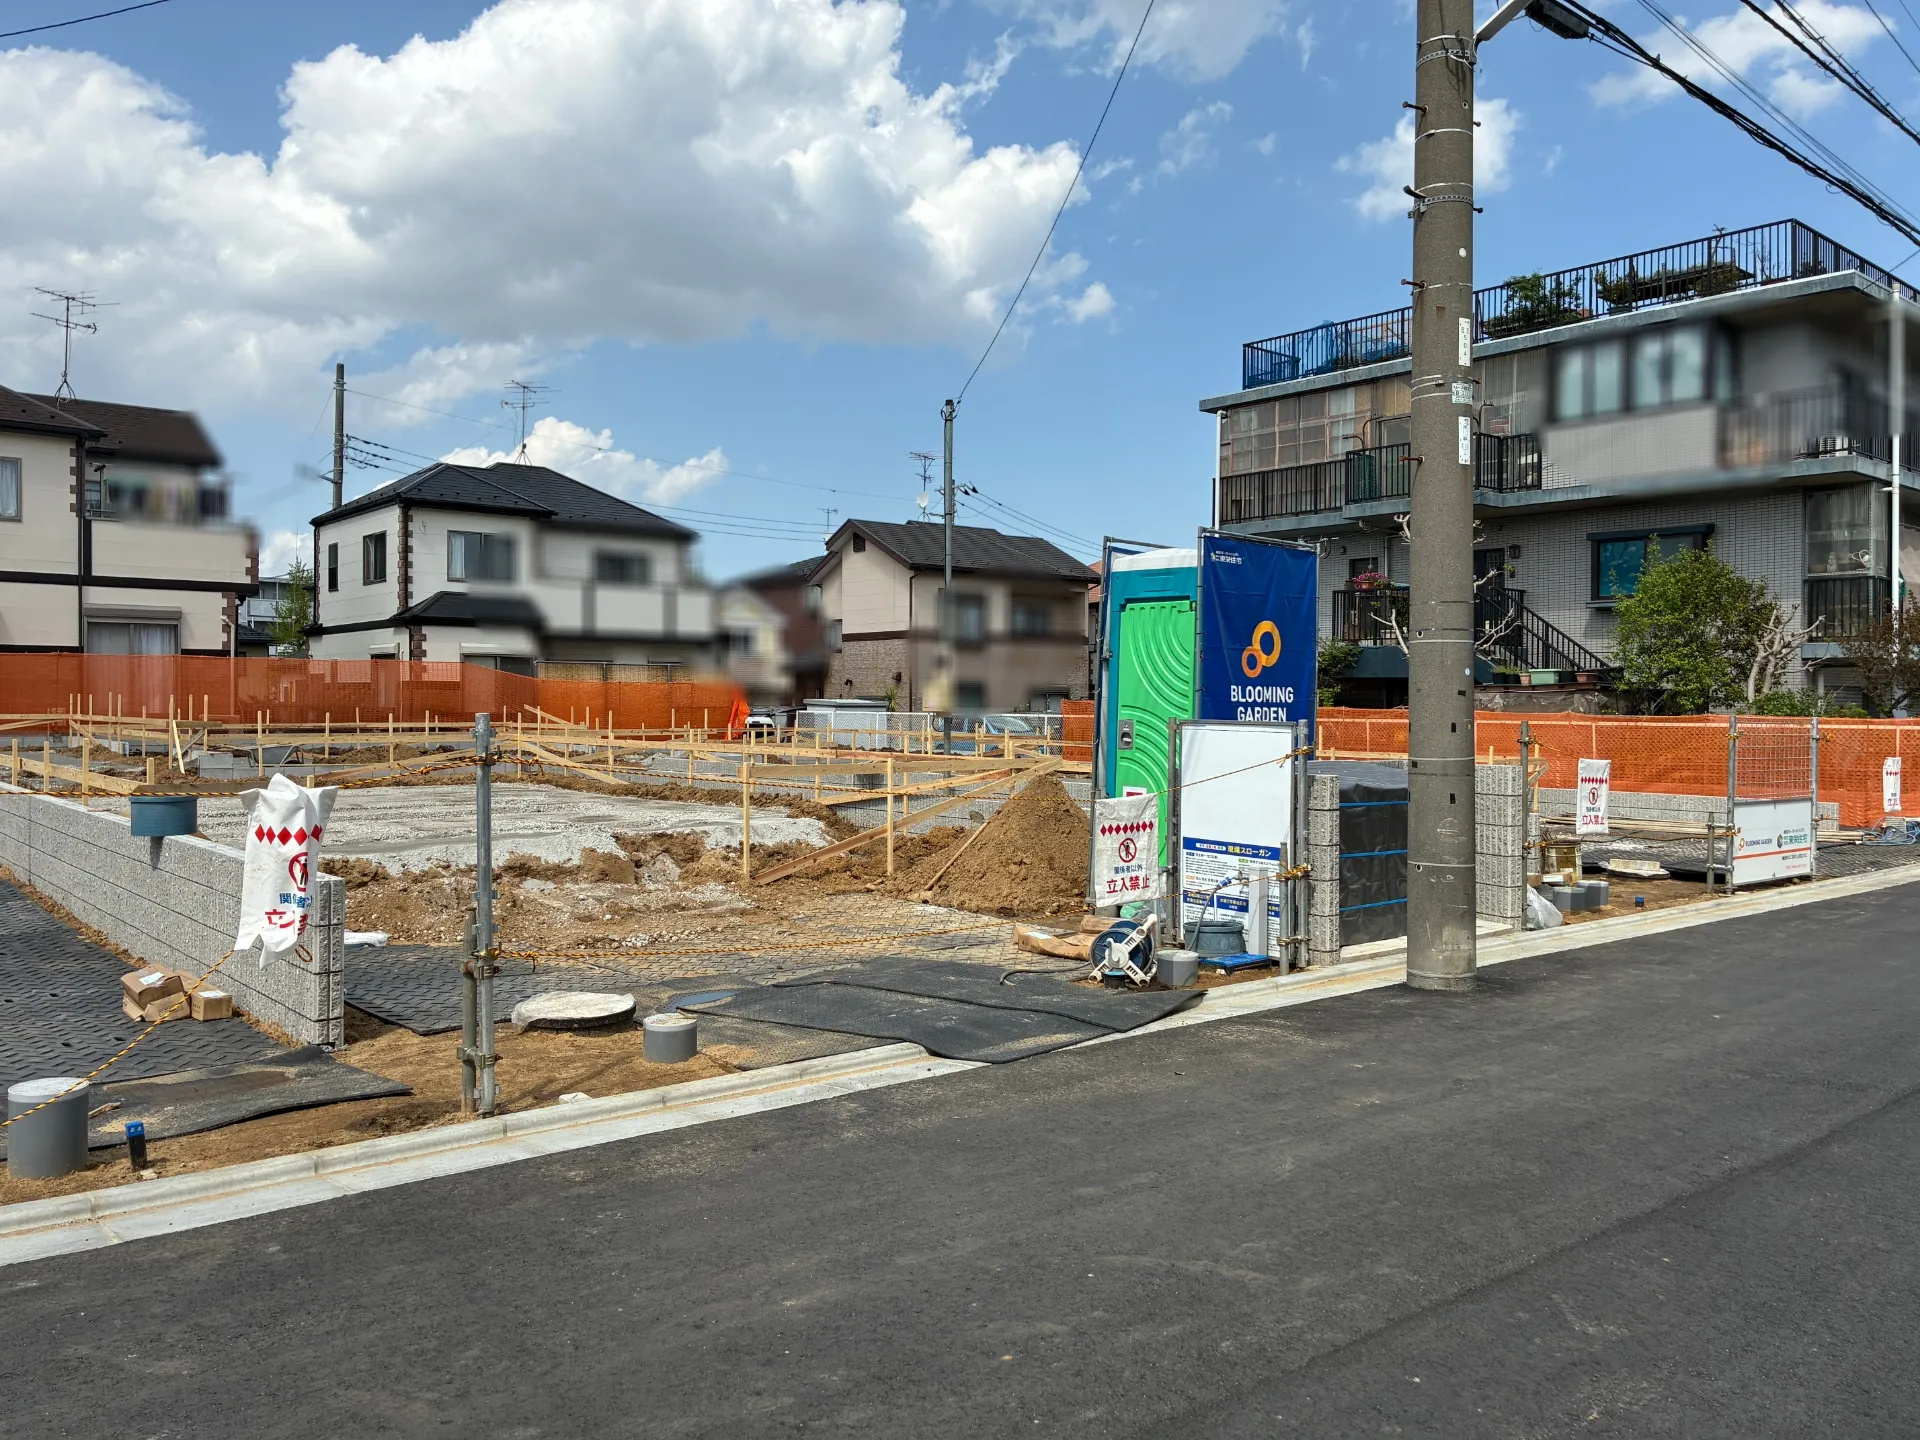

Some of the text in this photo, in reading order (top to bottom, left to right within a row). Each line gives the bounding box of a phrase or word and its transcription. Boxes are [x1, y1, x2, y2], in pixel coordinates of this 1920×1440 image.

[1230, 685, 1294, 703] BLOOMING
[1237, 706, 1287, 722] GARDEN
[1114, 864, 1143, 875] 関係者以外
[1106, 874, 1150, 894] 立入禁止
